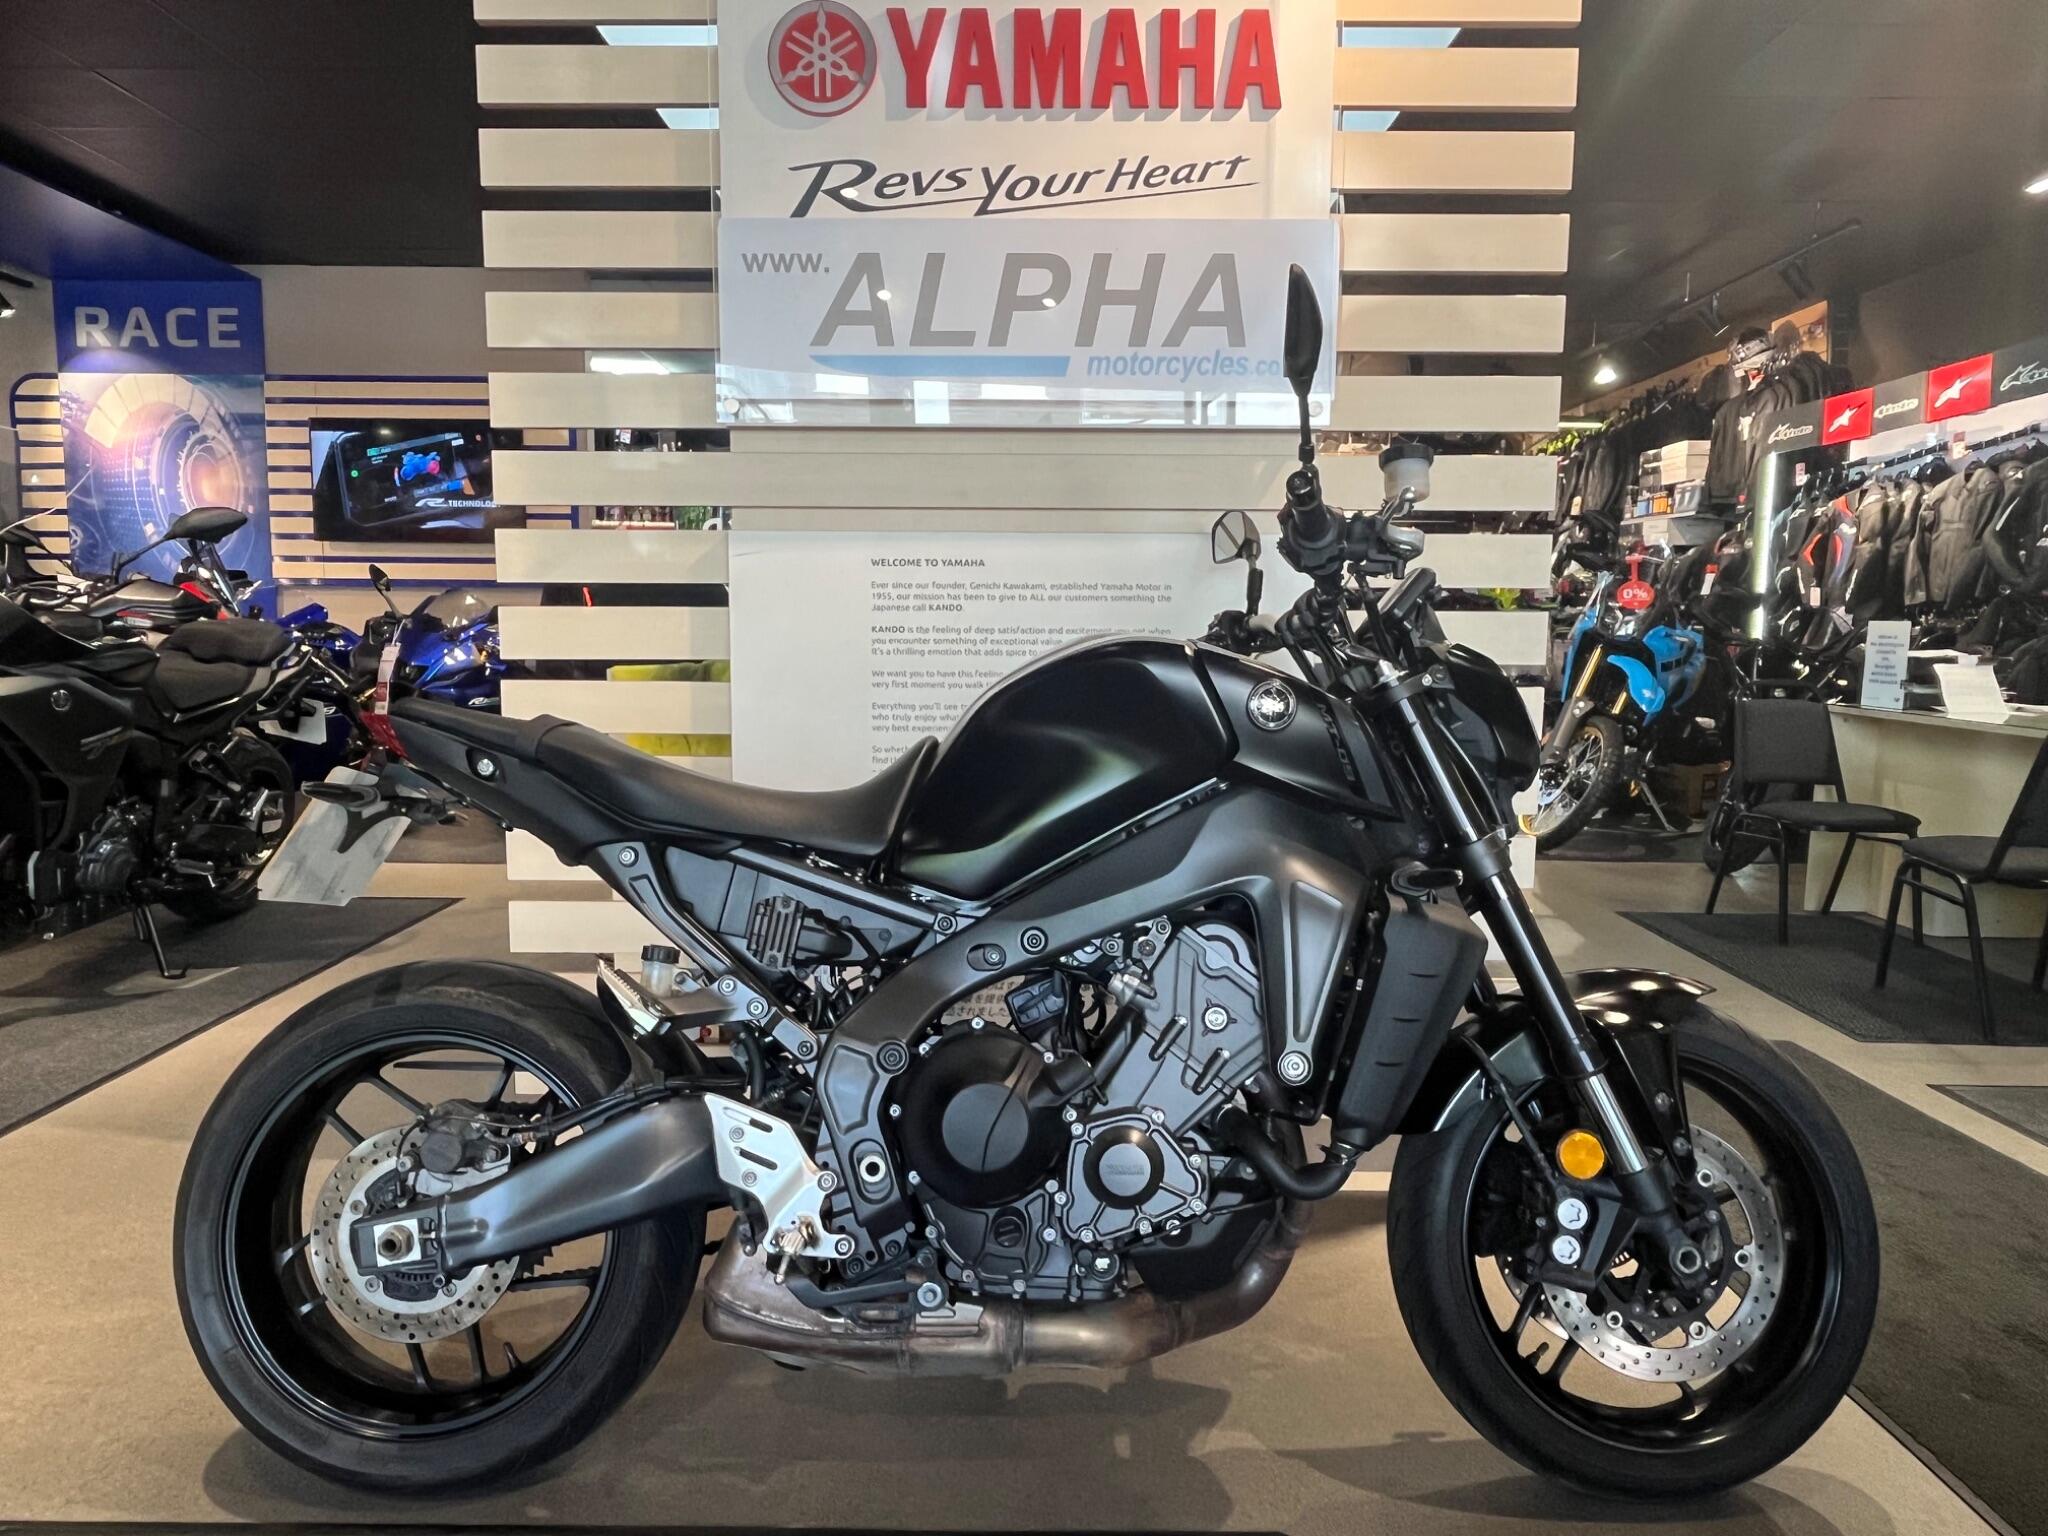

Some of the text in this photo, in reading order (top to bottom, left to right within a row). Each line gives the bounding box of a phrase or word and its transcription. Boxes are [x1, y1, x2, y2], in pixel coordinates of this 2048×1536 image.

[886, 7, 1282, 109] YAMAHA
[789, 155, 1252, 218] Revs Your Heart
[741, 252, 1248, 348] www. ALPHA
[74, 306, 241, 349] RACE
[1087, 349, 1281, 383] motorcycles.co
[871, 558, 985, 567] WELCOME TO YAMAHA
[871, 581, 889, 590] Ever
[891, 581, 913, 590] since
[932, 581, 968, 591] founder,
[969, 581, 1001, 590] Genichi
[1003, 582, 1047, 592] Kawakami,
[1049, 582, 1098, 591] established
[1100, 582, 1133, 591] Yamaha
[1135, 583, 1161, 591] Motor
[1164, 583, 1172, 591] in
[872, 592, 895, 602] 1955,
[913, 592, 945, 601] mission
[946, 592, 961, 601] has
[963, 592, 985, 601] been
[999, 593, 1016, 603] give
[1029, 593, 1046, 601] ALL
[1064, 594, 1108, 602] customers
[1110, 593, 1155, 603] something
[1157, 594, 1172, 602] the
[1622, 588, 1648, 599] 0%
[871, 603, 910, 613] Japanese
[912, 603, 927, 612] call
[871, 625, 906, 634] KANDO
[907, 625, 914, 634] is
[916, 625, 930, 634] the
[932, 625, 962, 636] feeling
[963, 625, 972, 634] of
[974, 626, 996, 636] deep
[998, 626, 1046, 635] satisfaction
[1047, 626, 1064, 635] and
[871, 638, 887, 647] you
[888, 637, 930, 645] encounter
[932, 636, 977, 647] something
[979, 636, 988, 645] of
[990, 637, 1038, 647] exceptional
[893, 647, 926, 658] thrilling
[927, 648, 959, 656] emotion
[960, 648, 982, 656] that
[983, 648, 1003, 657] adds
[1005, 648, 1026, 658] spice
[871, 670, 885, 678] We
[886, 670, 907, 678] want
[909, 671, 925, 680] you
[936, 670, 956, 678] have
[958, 670, 974, 678] this
[871, 682, 889, 690] very
[891, 681, 908, 689] first
[910, 681, 946, 689] moment
[964, 681, 984, 689] walk
[872, 702, 916, 713] Everything
[871, 713, 889, 722] who
[892, 713, 912, 723] truly
[914, 714, 937, 723] enjoy
[871, 725, 890, 733] very
[891, 724, 910, 732] best
[872, 745, 882, 753] So
[872, 756, 889, 765] find
